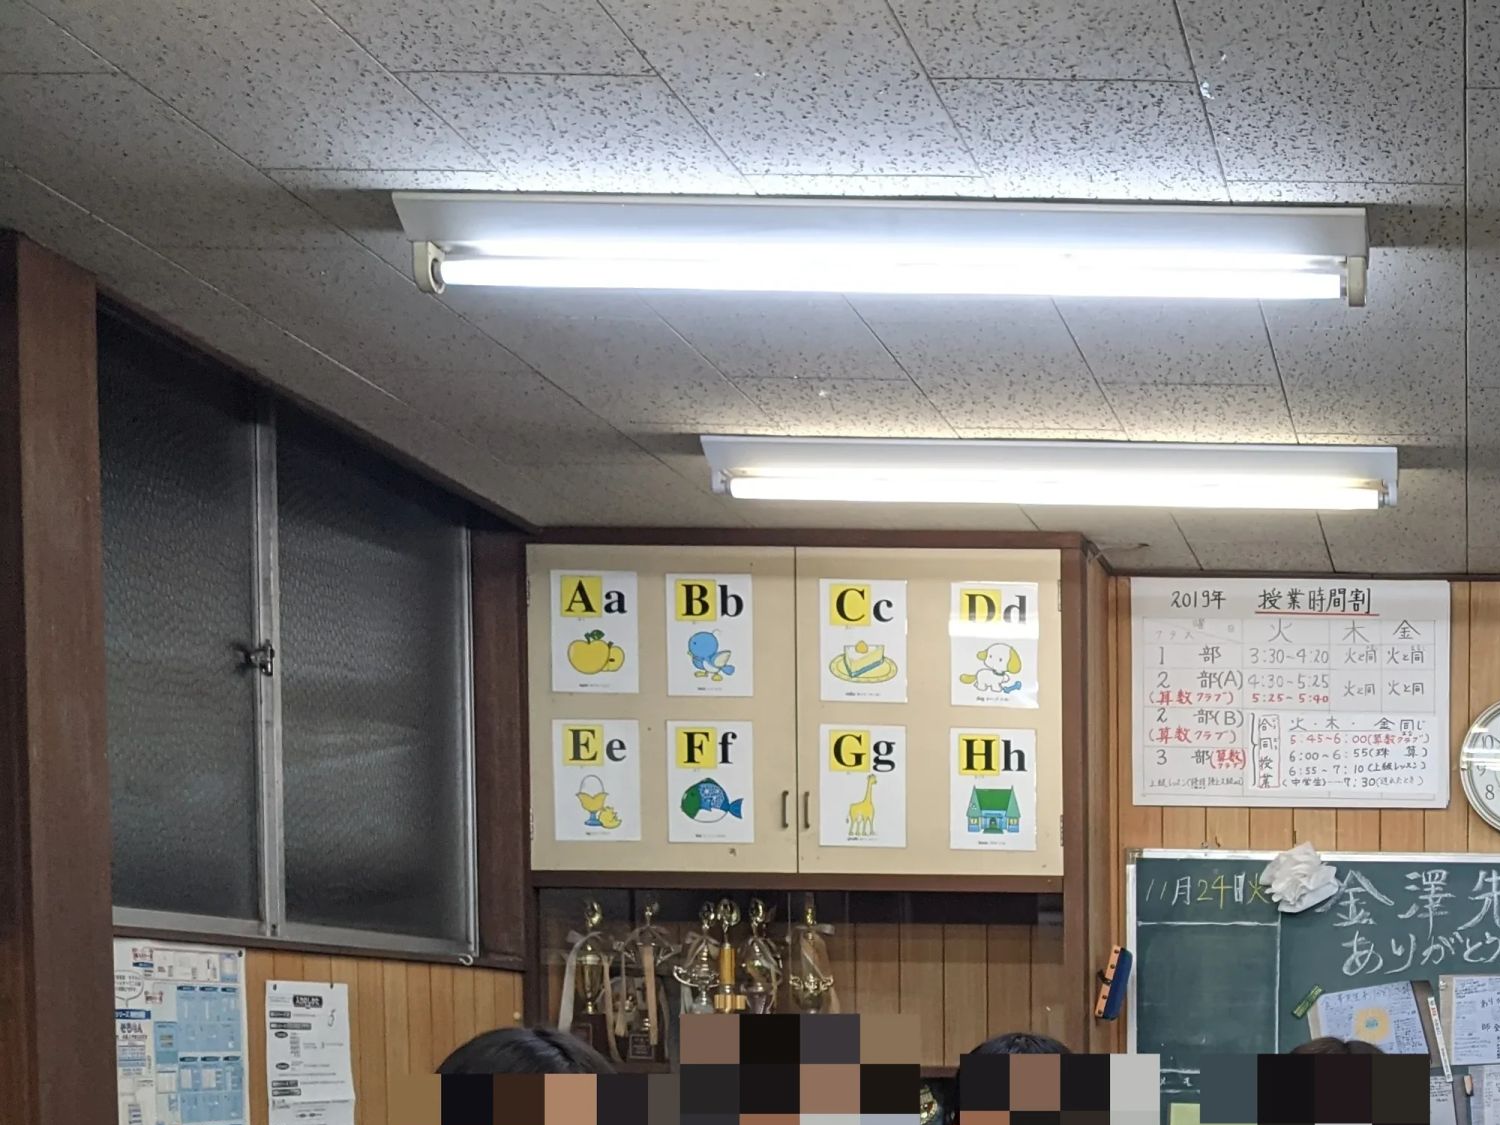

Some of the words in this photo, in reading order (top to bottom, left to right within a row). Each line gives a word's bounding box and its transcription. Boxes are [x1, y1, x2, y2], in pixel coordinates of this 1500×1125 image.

[565, 580, 627, 614] Aa
[682, 583, 743, 618] Bb
[836, 588, 893, 623] Cc
[965, 594, 1027, 624] Dd
[1171, 590, 1226, 609] 2019年
[1258, 587, 1372, 614] 授業時間割
[1268, 618, 1293, 643] 火
[1342, 620, 1370, 643] 木
[1393, 619, 1421, 640] 金
[569, 729, 626, 762] Ee
[683, 731, 737, 765] Ff
[833, 734, 895, 772] Gg
[961, 738, 1027, 772] Hh
[1481, 735, 1494, 750] 10
[1485, 785, 1495, 800] 8
